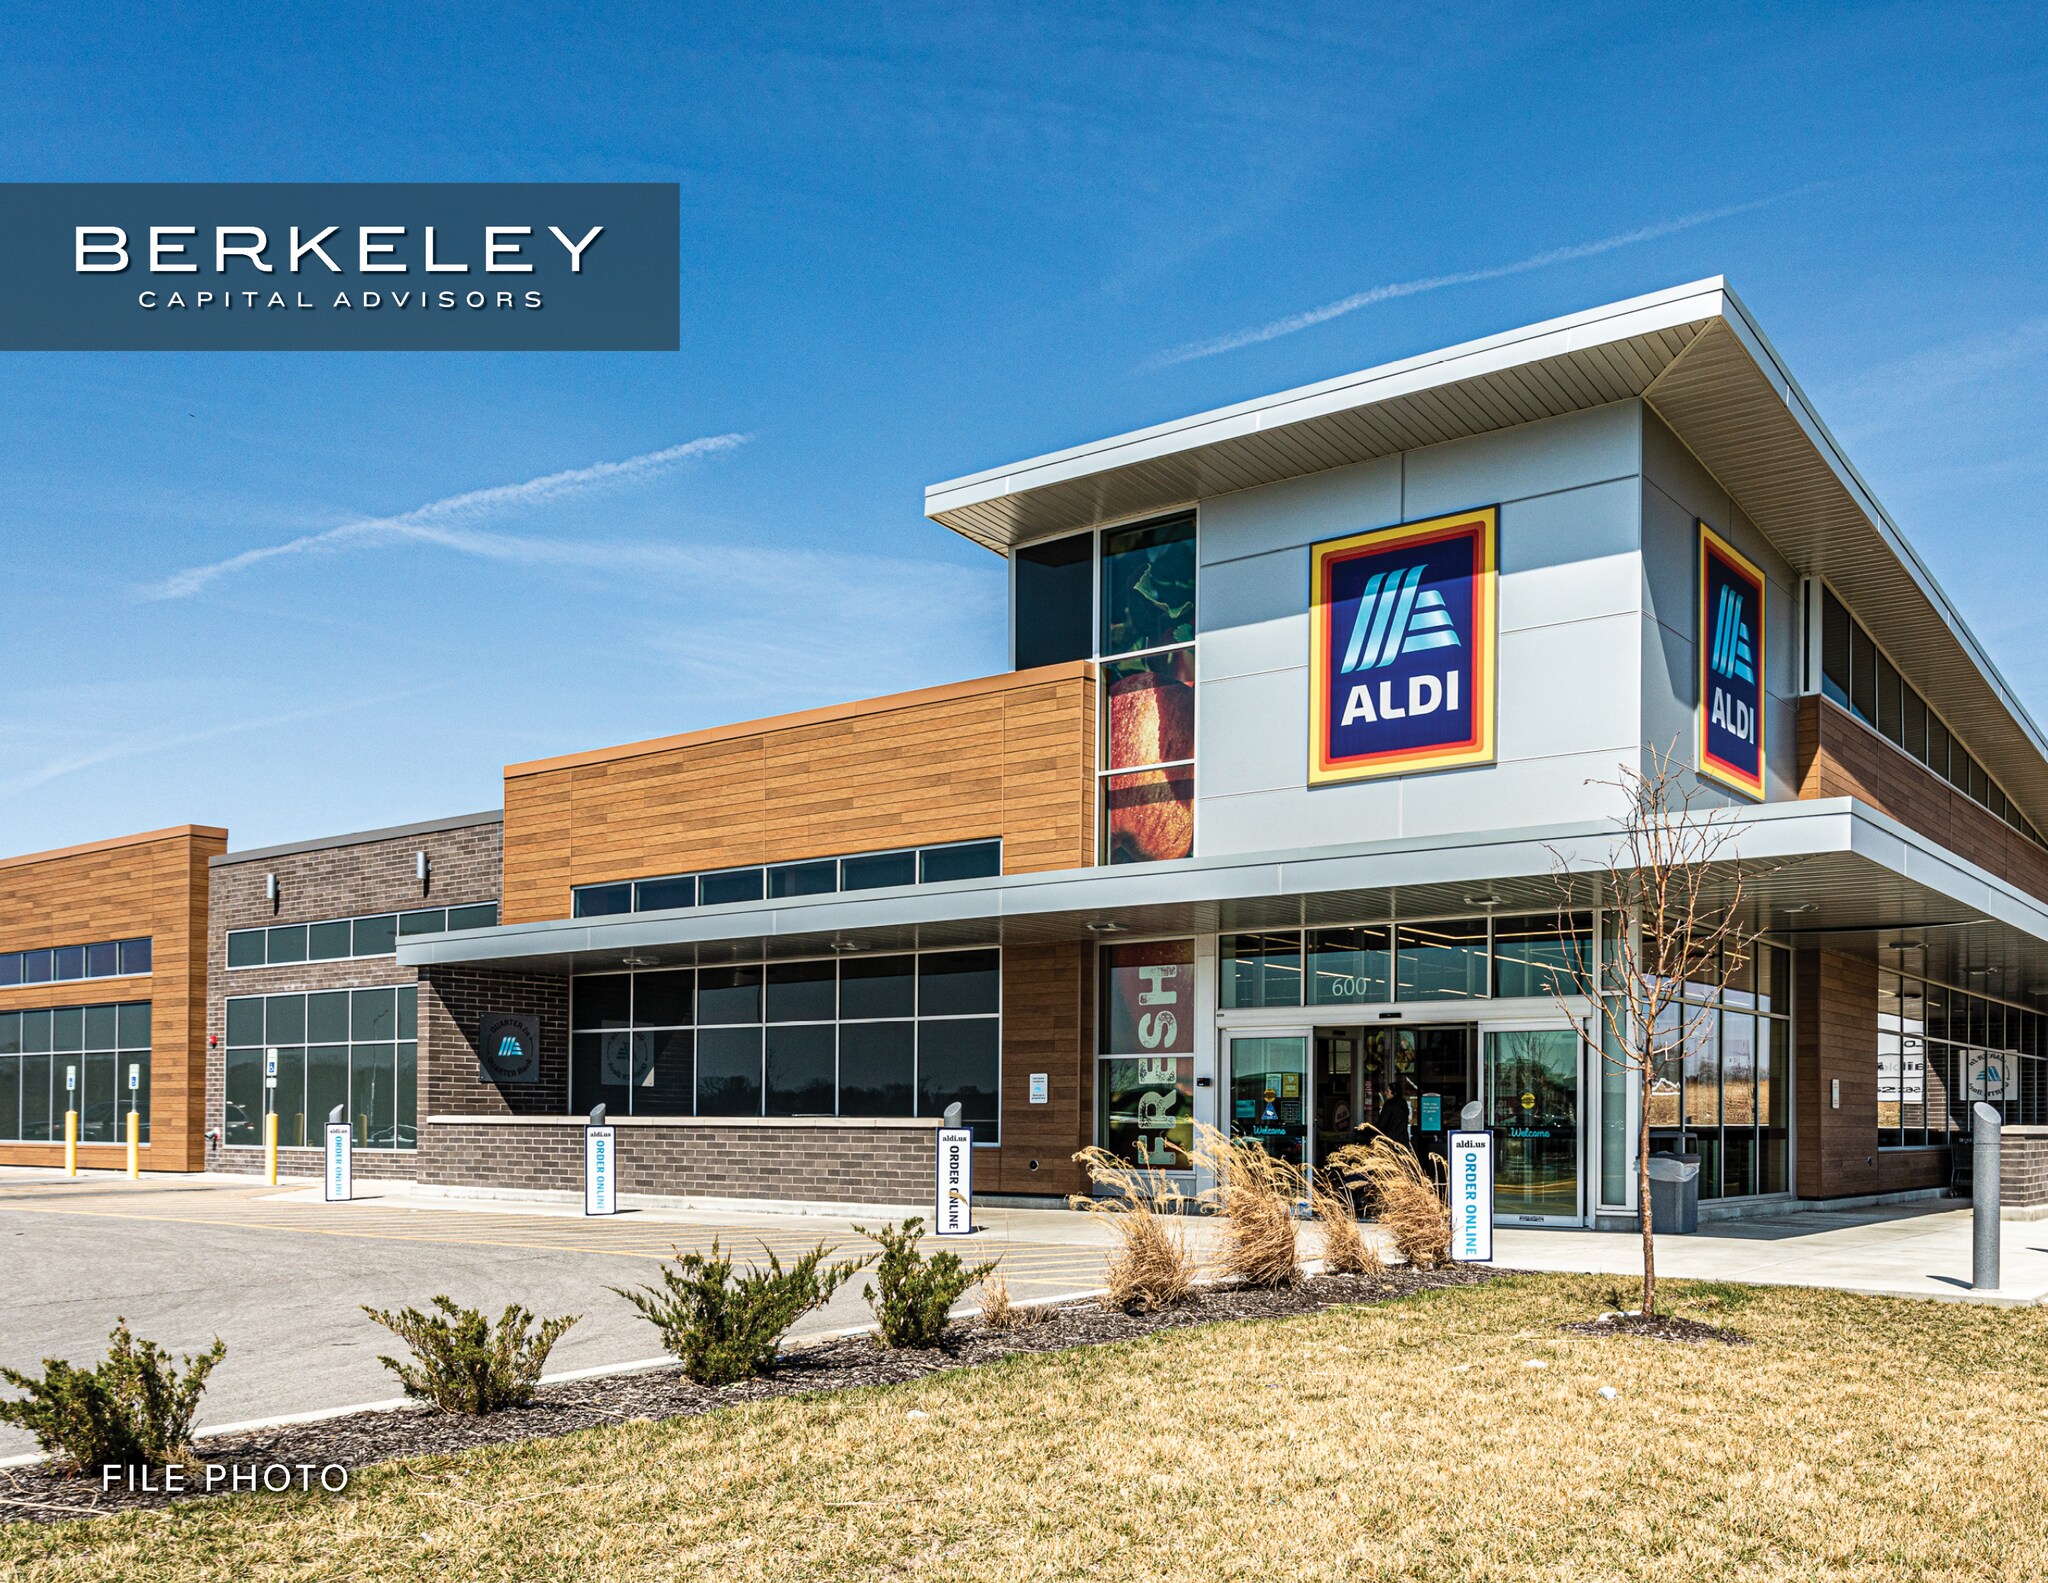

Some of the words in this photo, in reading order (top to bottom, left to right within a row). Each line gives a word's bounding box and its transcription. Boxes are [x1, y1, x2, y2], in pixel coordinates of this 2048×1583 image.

[1340, 670, 1459, 727] ALDI
[1711, 686, 1755, 746] ALDI
[1332, 976, 1367, 997] 600
[490, 1018, 523, 1034] QUARTER
[487, 1057, 517, 1077] QUARTER
[1137, 964, 1178, 1165] FRESH
[1253, 1125, 1286, 1135] Welcome
[1456, 1140, 1486, 1149] aldi.us
[1511, 1127, 1550, 1138] Welcome
[335, 1136, 343, 1165] ORDER
[596, 1140, 605, 1173] ORDER
[949, 1145, 960, 1185] ORDER
[596, 1176, 605, 1210] ONLINE
[1465, 1153, 1477, 1200] ORDER
[1465, 1204, 1477, 1255] ONLINE
